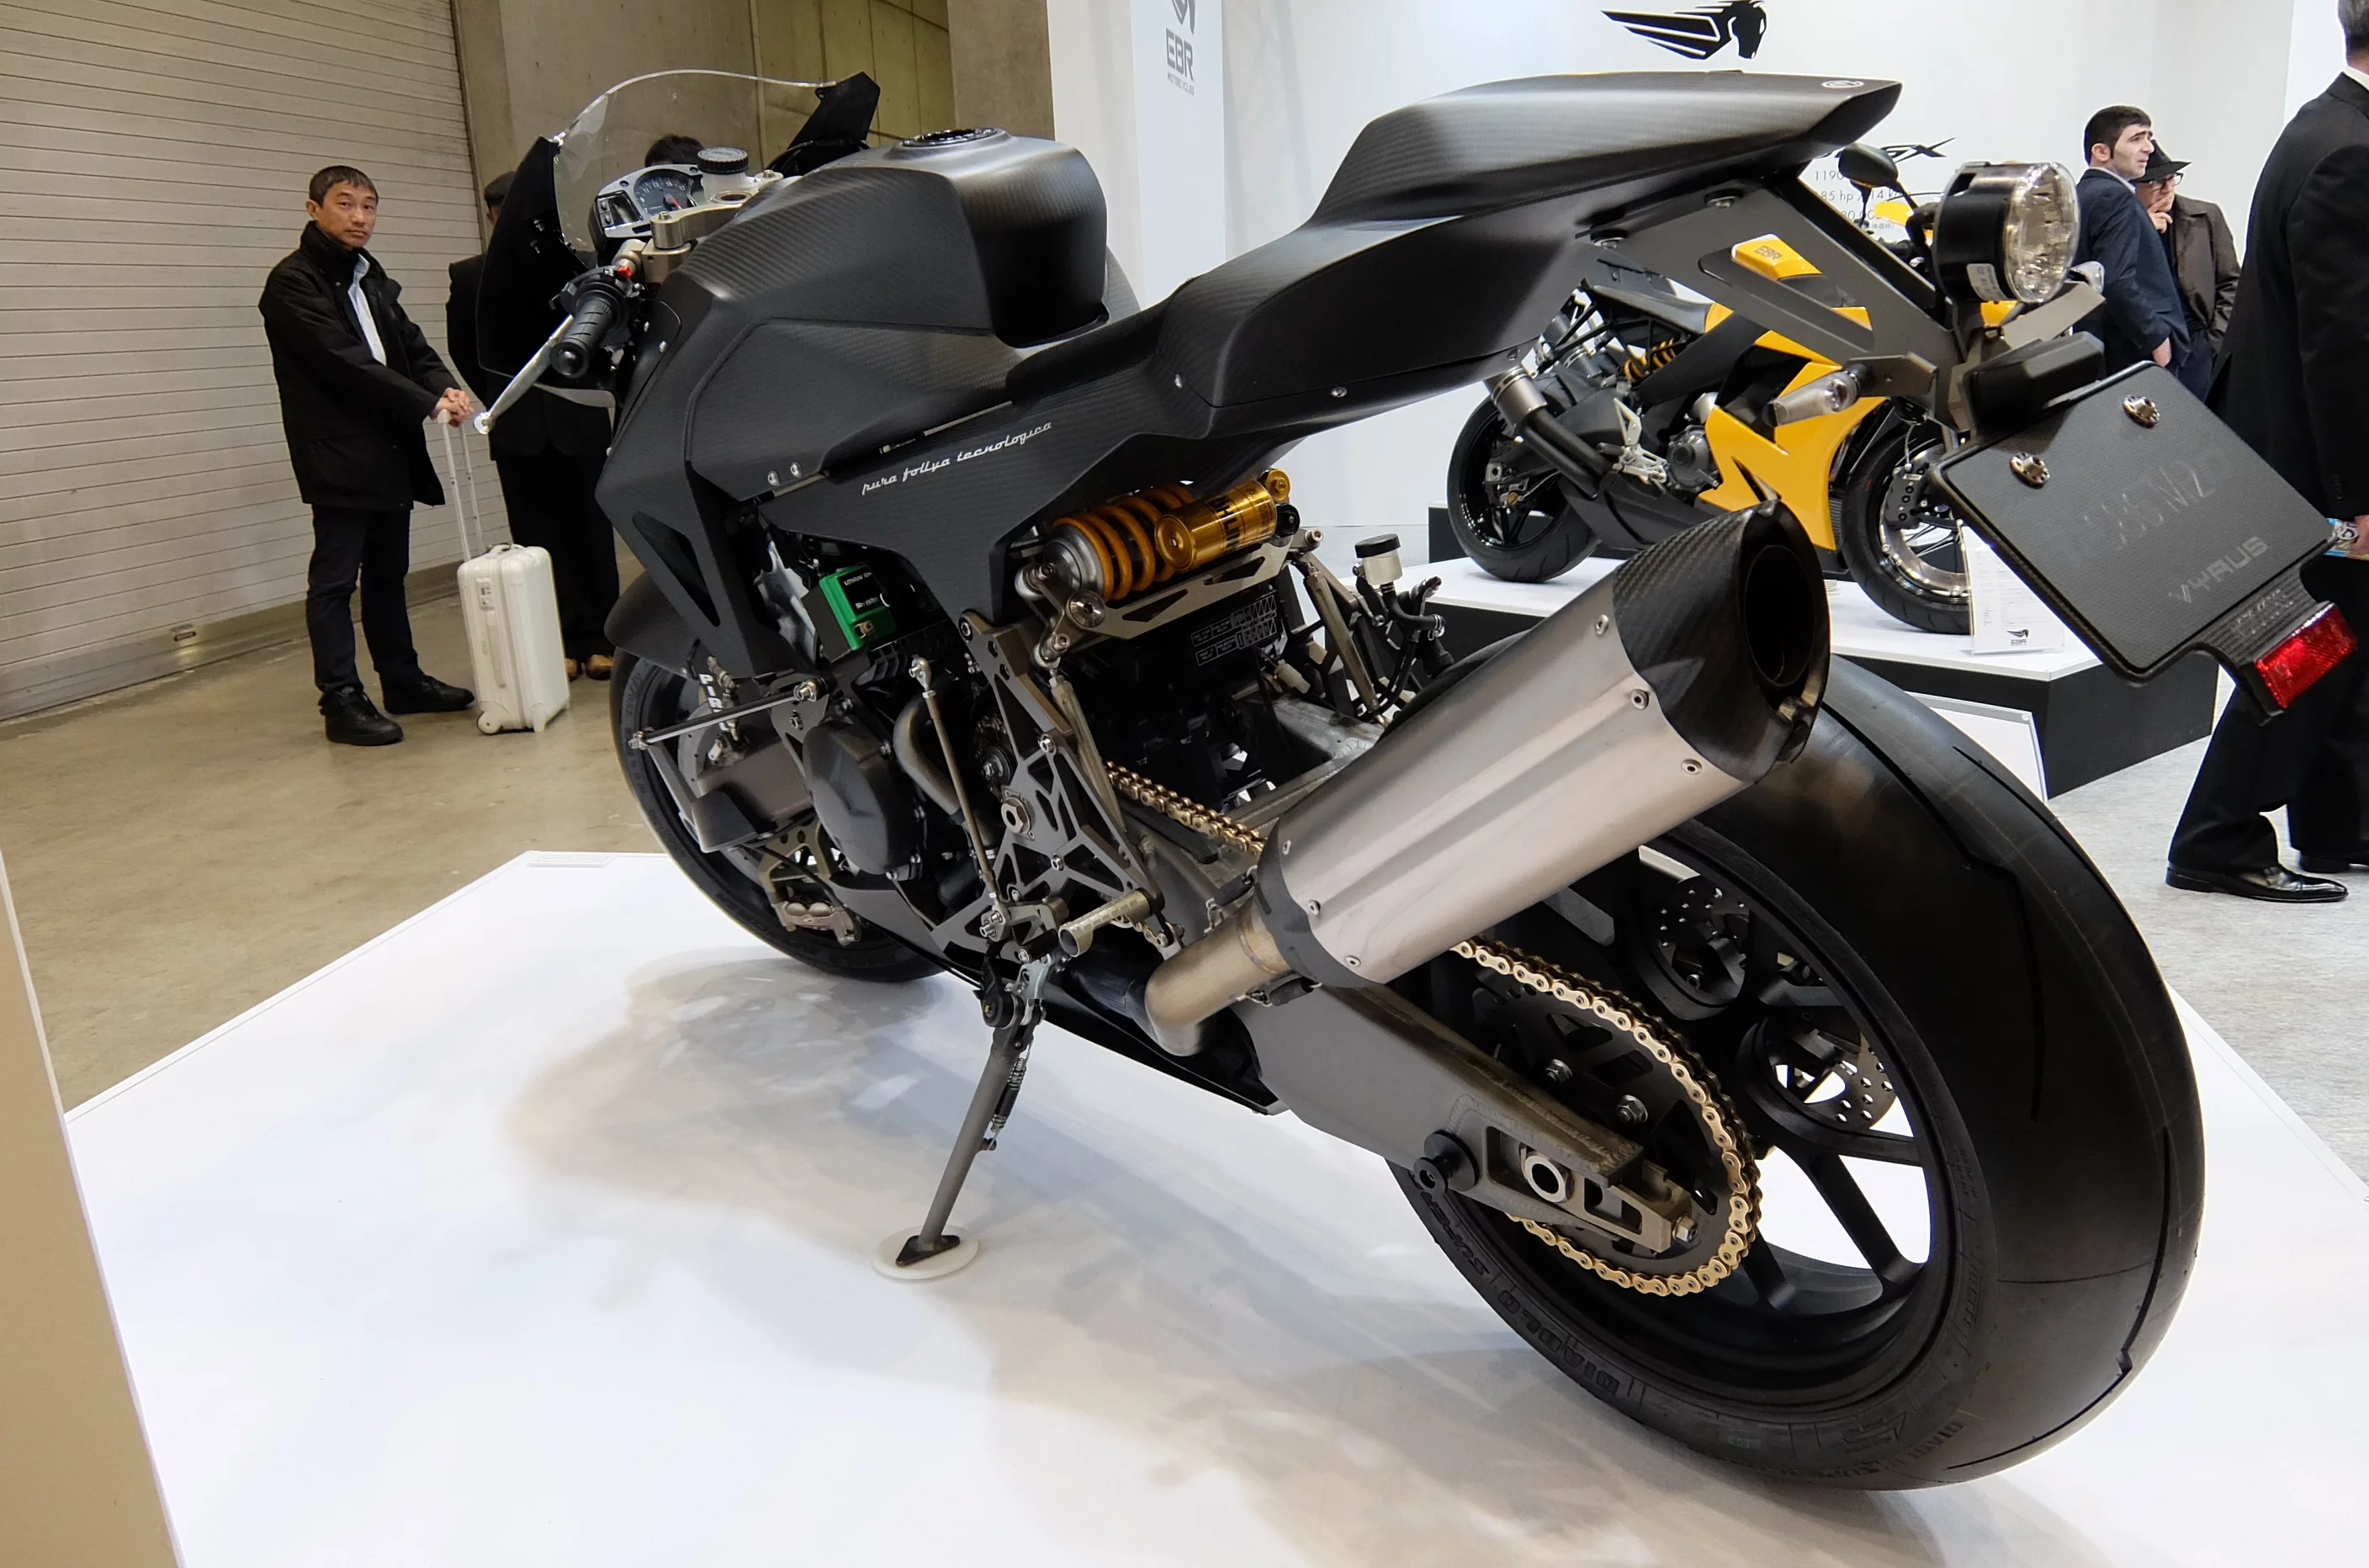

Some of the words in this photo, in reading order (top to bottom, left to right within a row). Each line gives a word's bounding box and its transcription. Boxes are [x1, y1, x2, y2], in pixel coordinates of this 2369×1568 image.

[1165, 27, 1195, 81] EBR
[1840, 189, 1854, 204] hp
[861, 474, 898, 495] pura
[902, 457, 951, 482] follya
[957, 421, 1052, 462] tecnologica
